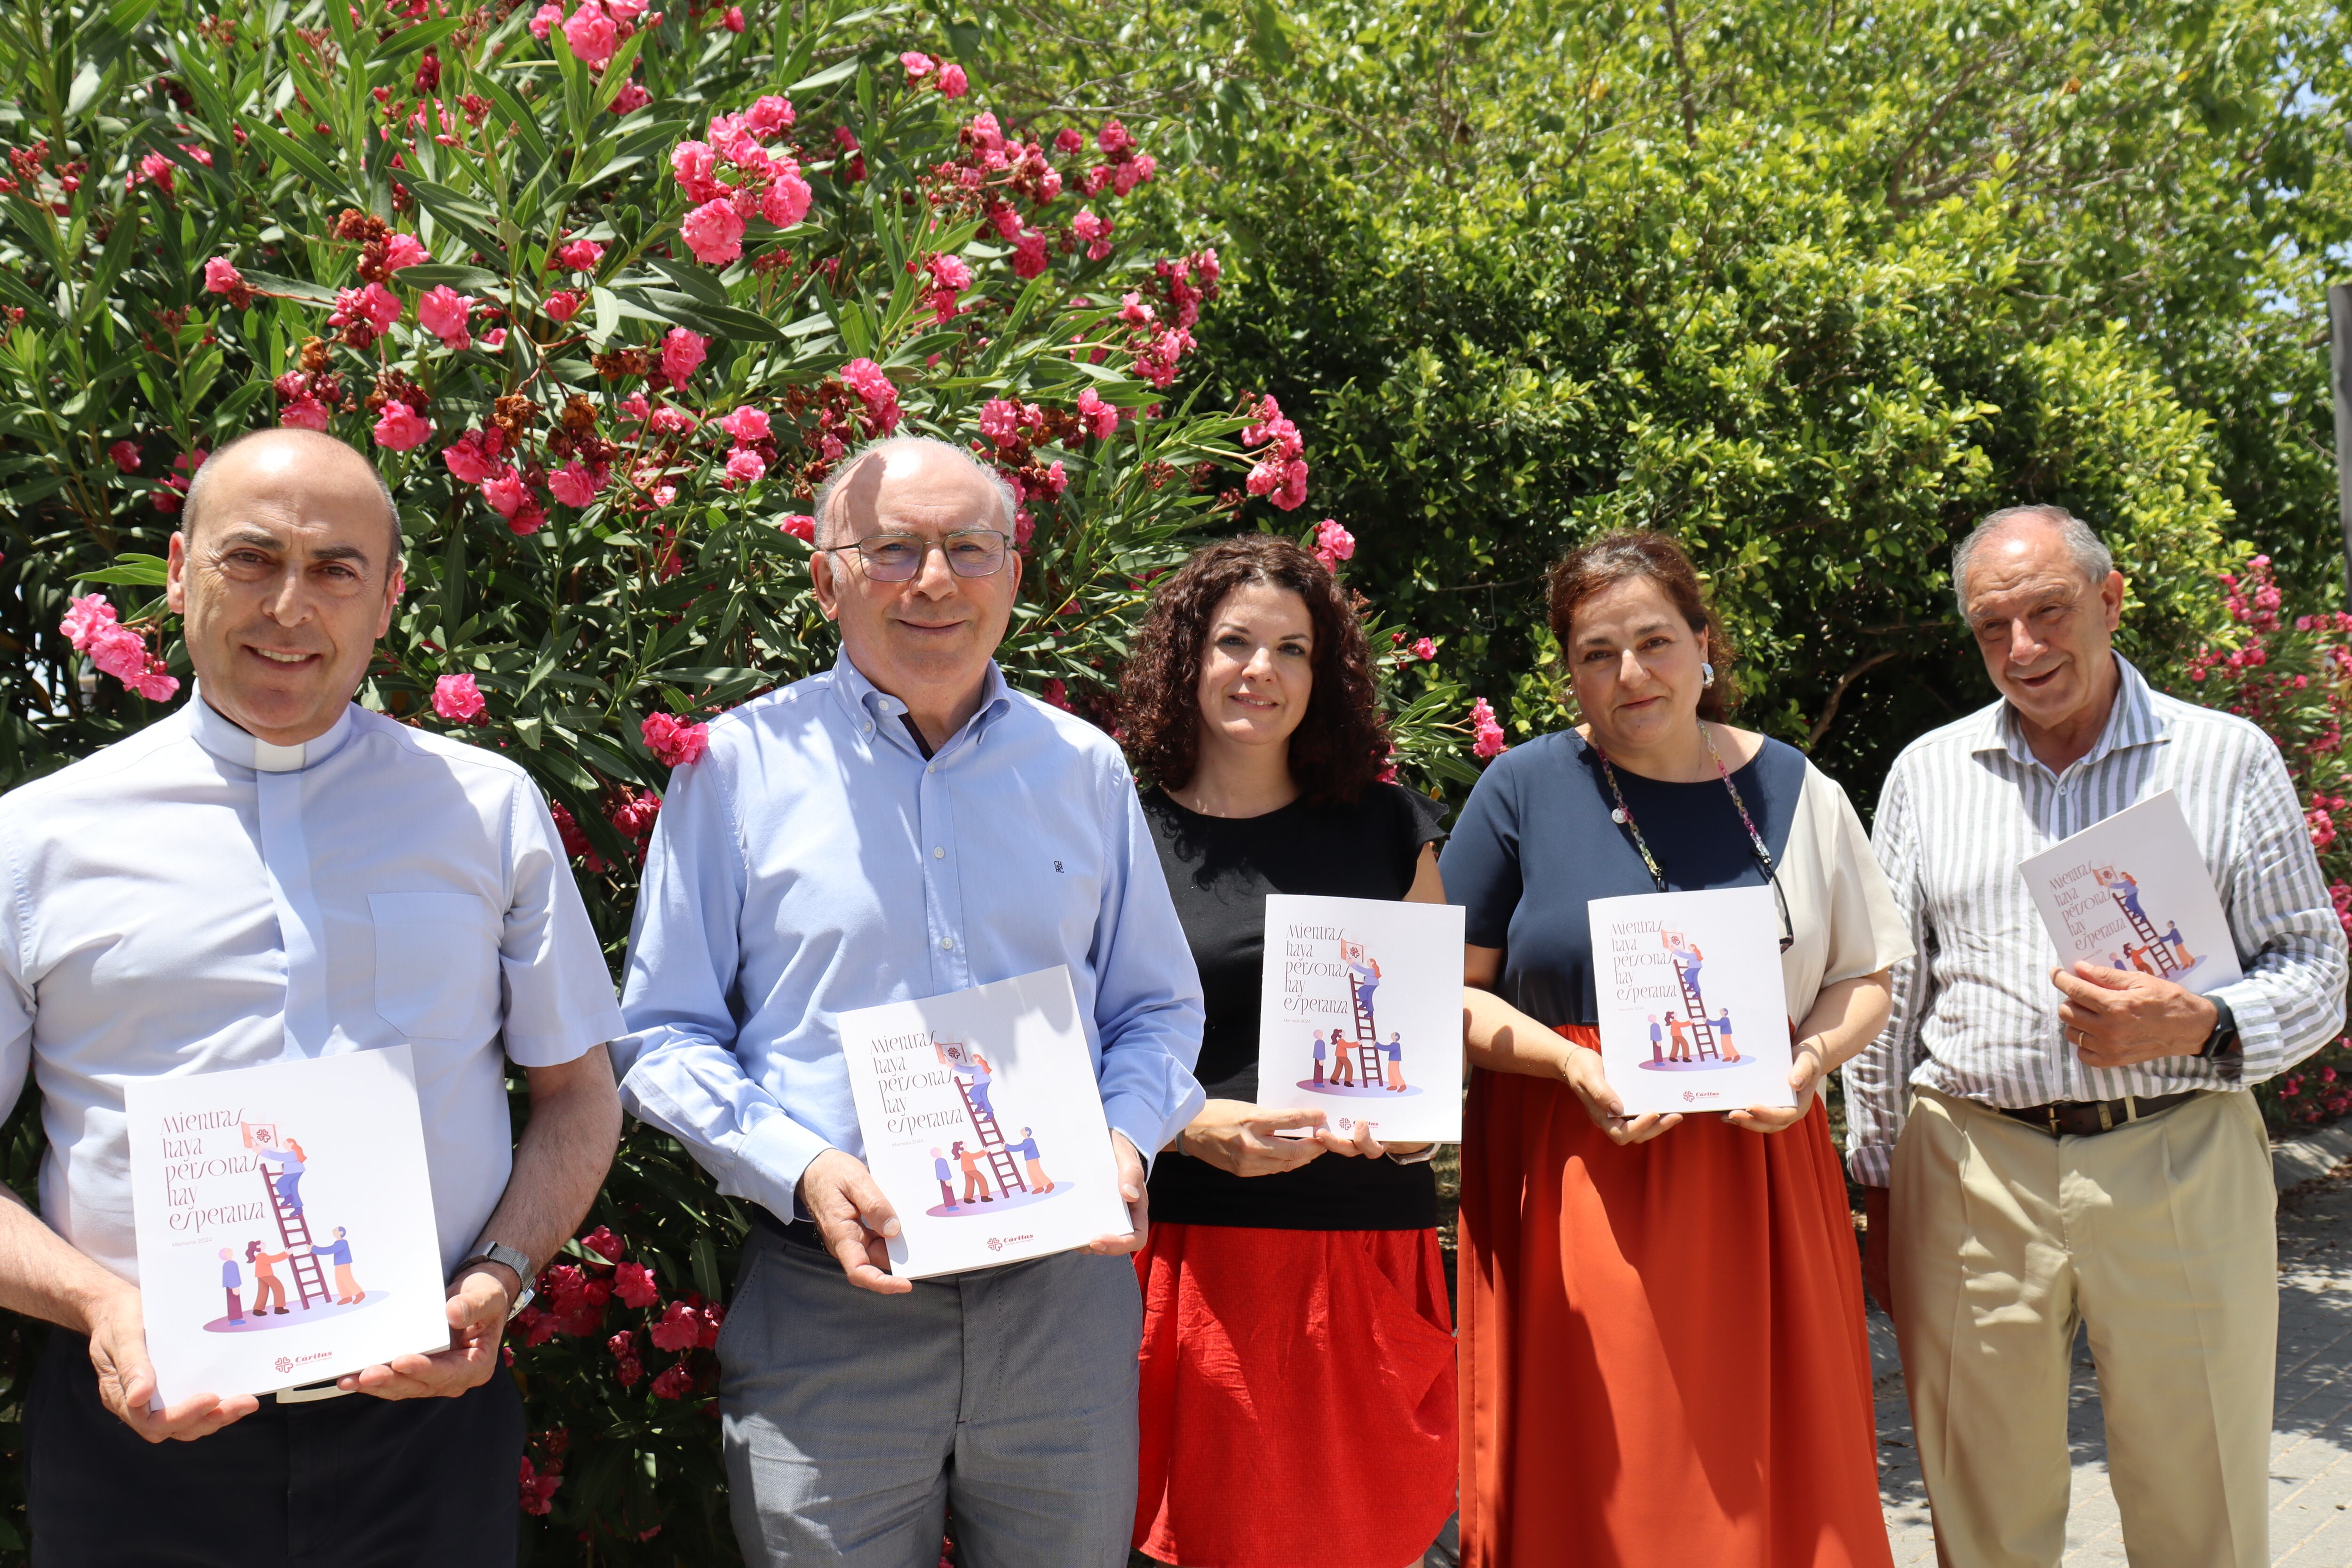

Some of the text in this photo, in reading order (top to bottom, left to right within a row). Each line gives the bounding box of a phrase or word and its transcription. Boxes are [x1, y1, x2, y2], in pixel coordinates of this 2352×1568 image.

[2049, 860, 2093, 893] Mientras
[2053, 887, 2079, 907] haya
[2061, 887, 2111, 927] personas
[1286, 922, 1346, 941] Mientras
[1610, 919, 1664, 936] Mientras
[2067, 919, 2087, 938] hay
[2075, 917, 2127, 951] esperanza
[1286, 940, 1313, 961] haya
[1612, 938, 1637, 955] haya
[1286, 961, 1350, 978] personas
[1613, 952, 1673, 971] personas
[1285, 977, 1306, 997] hay
[1615, 970, 1635, 987] hay
[1617, 985, 1677, 1003] esperanza
[1283, 997, 1349, 1015] esperanza
[870, 1030, 937, 1055] Mientras
[873, 1056, 907, 1077] haya
[878, 1068, 953, 1097] personas
[883, 1096, 906, 1116] hay
[160, 1108, 246, 1136] Mientras
[887, 1108, 965, 1136] esperanza
[163, 1138, 204, 1162] haya
[165, 1154, 260, 1186] personas
[167, 1184, 198, 1210] hay
[169, 1201, 266, 1233] esperanza
[1003, 1234, 1033, 1243] Cáritas
[295, 1351, 332, 1363] Cáritas
